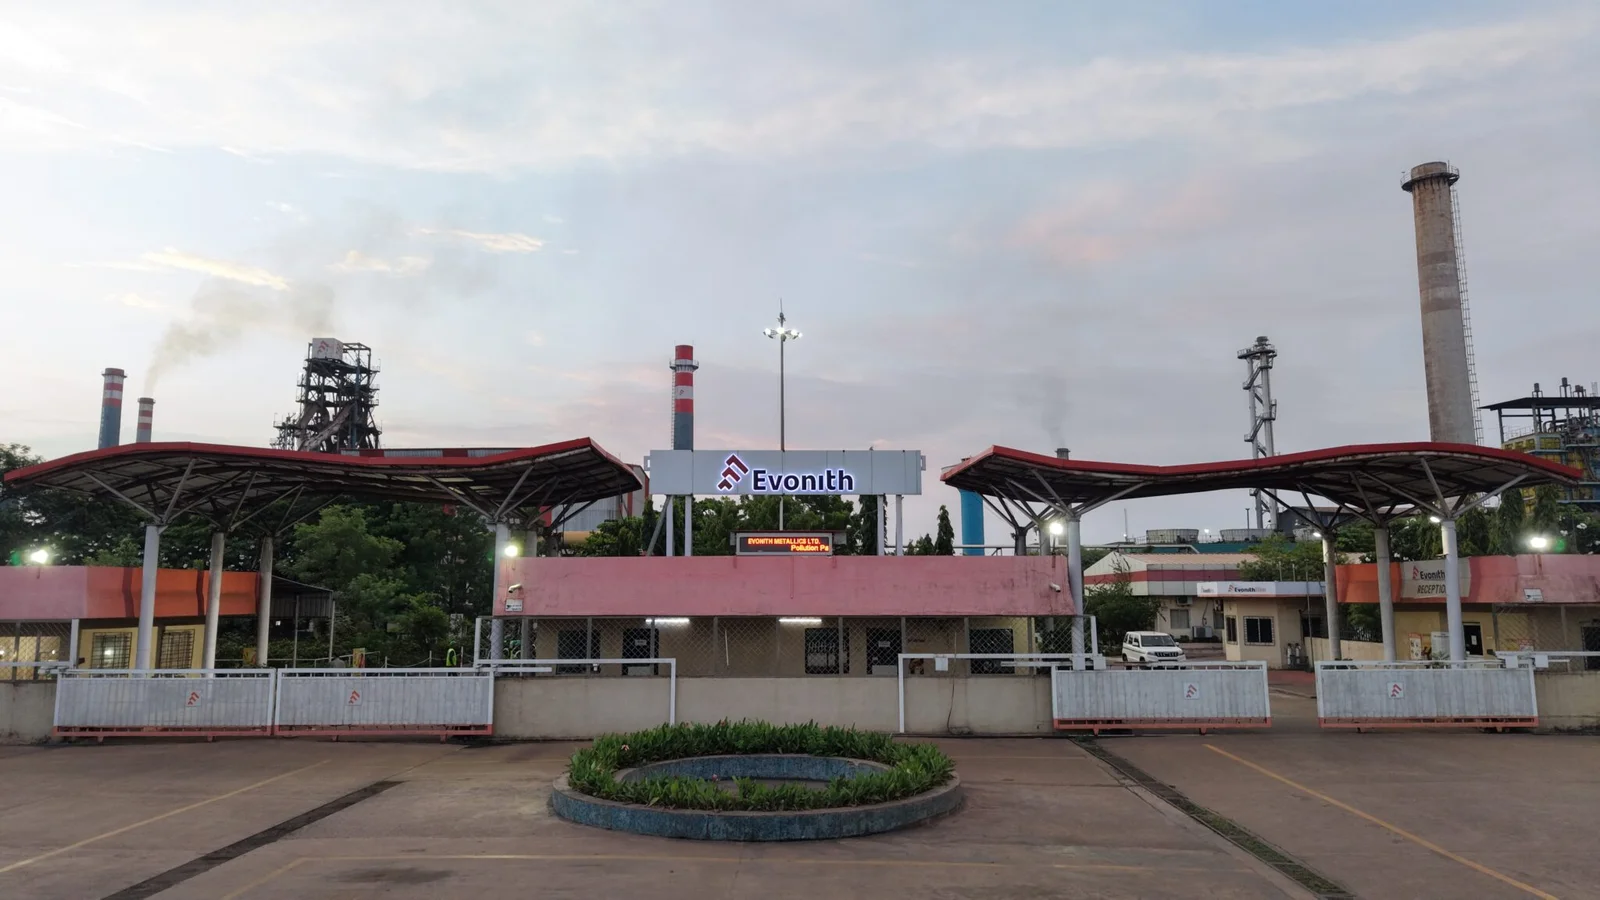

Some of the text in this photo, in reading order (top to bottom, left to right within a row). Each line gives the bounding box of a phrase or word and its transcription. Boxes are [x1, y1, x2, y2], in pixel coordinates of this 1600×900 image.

[753, 469, 854, 491] Evonith
[1420, 570, 1445, 580] Evonith
[1417, 584, 1446, 594] RECEPTIO
